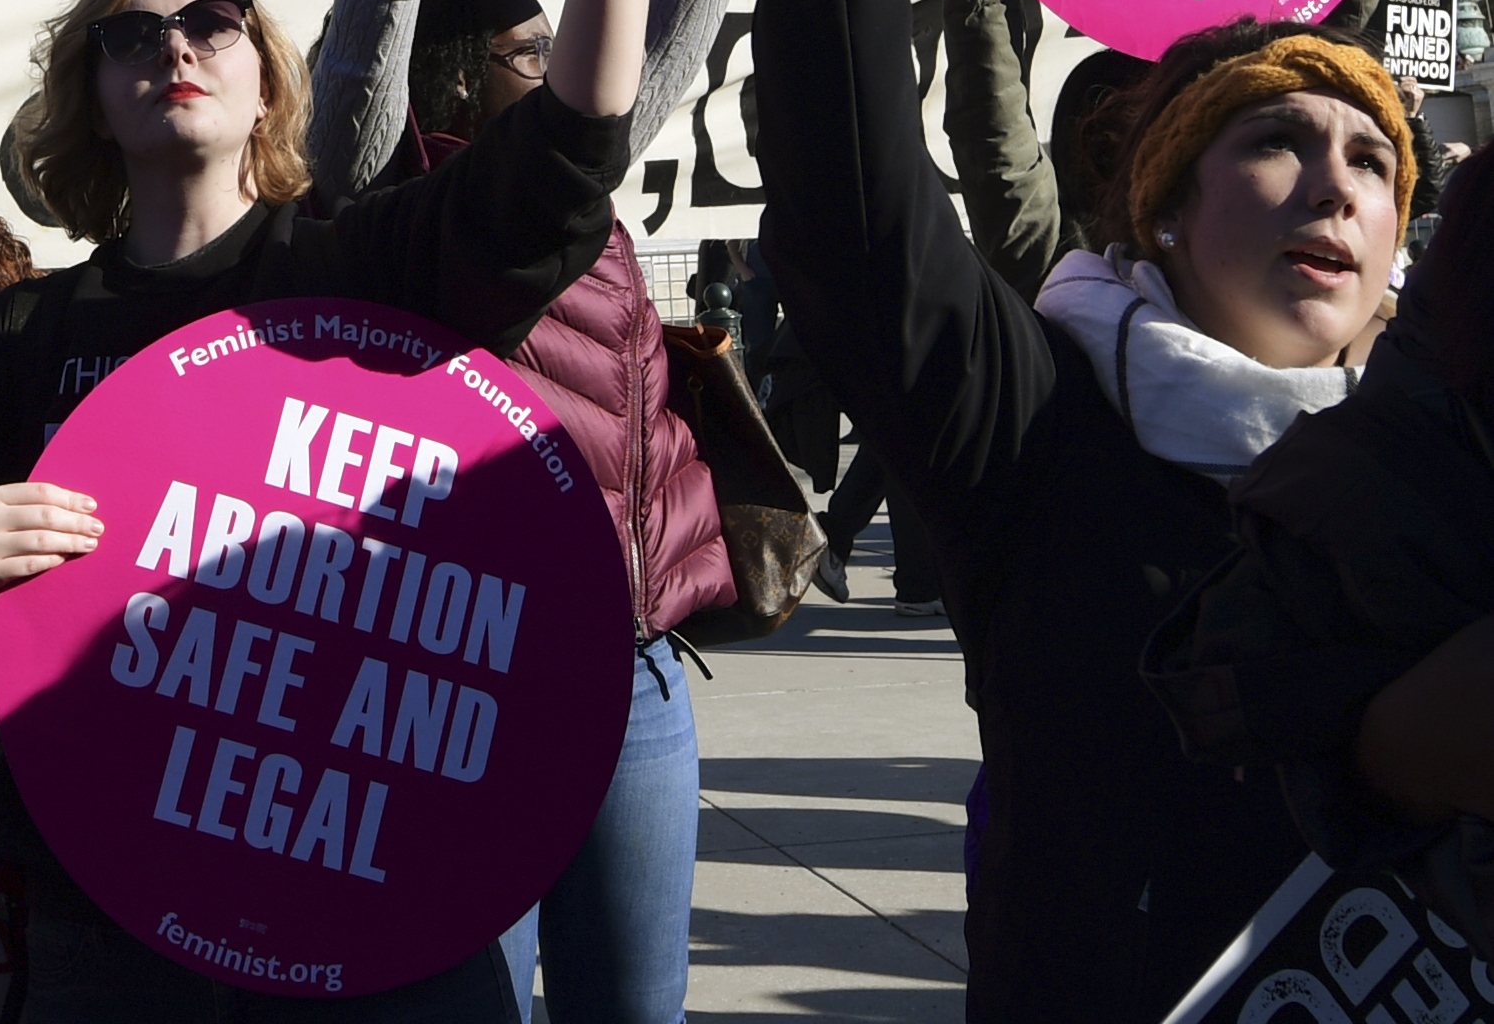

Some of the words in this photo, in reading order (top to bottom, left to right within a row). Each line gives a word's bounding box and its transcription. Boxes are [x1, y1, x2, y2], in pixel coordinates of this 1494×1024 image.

[1383, 57, 1449, 80] ENTHOOD
[1384, 32, 1450, 62] ANNED
[1387, 4, 1451, 37] FUND
[169, 318, 303, 376] Feminist
[314, 314, 442, 369] Majority
[446, 352, 574, 493] Foundation
[264, 396, 460, 529] KEEP
[135, 480, 526, 674] ABORTION
[110, 592, 316, 732] SAFE
[329, 656, 499, 784] AND
[152, 725, 390, 883] LEGAL
[156, 912, 343, 992] feminist.org
